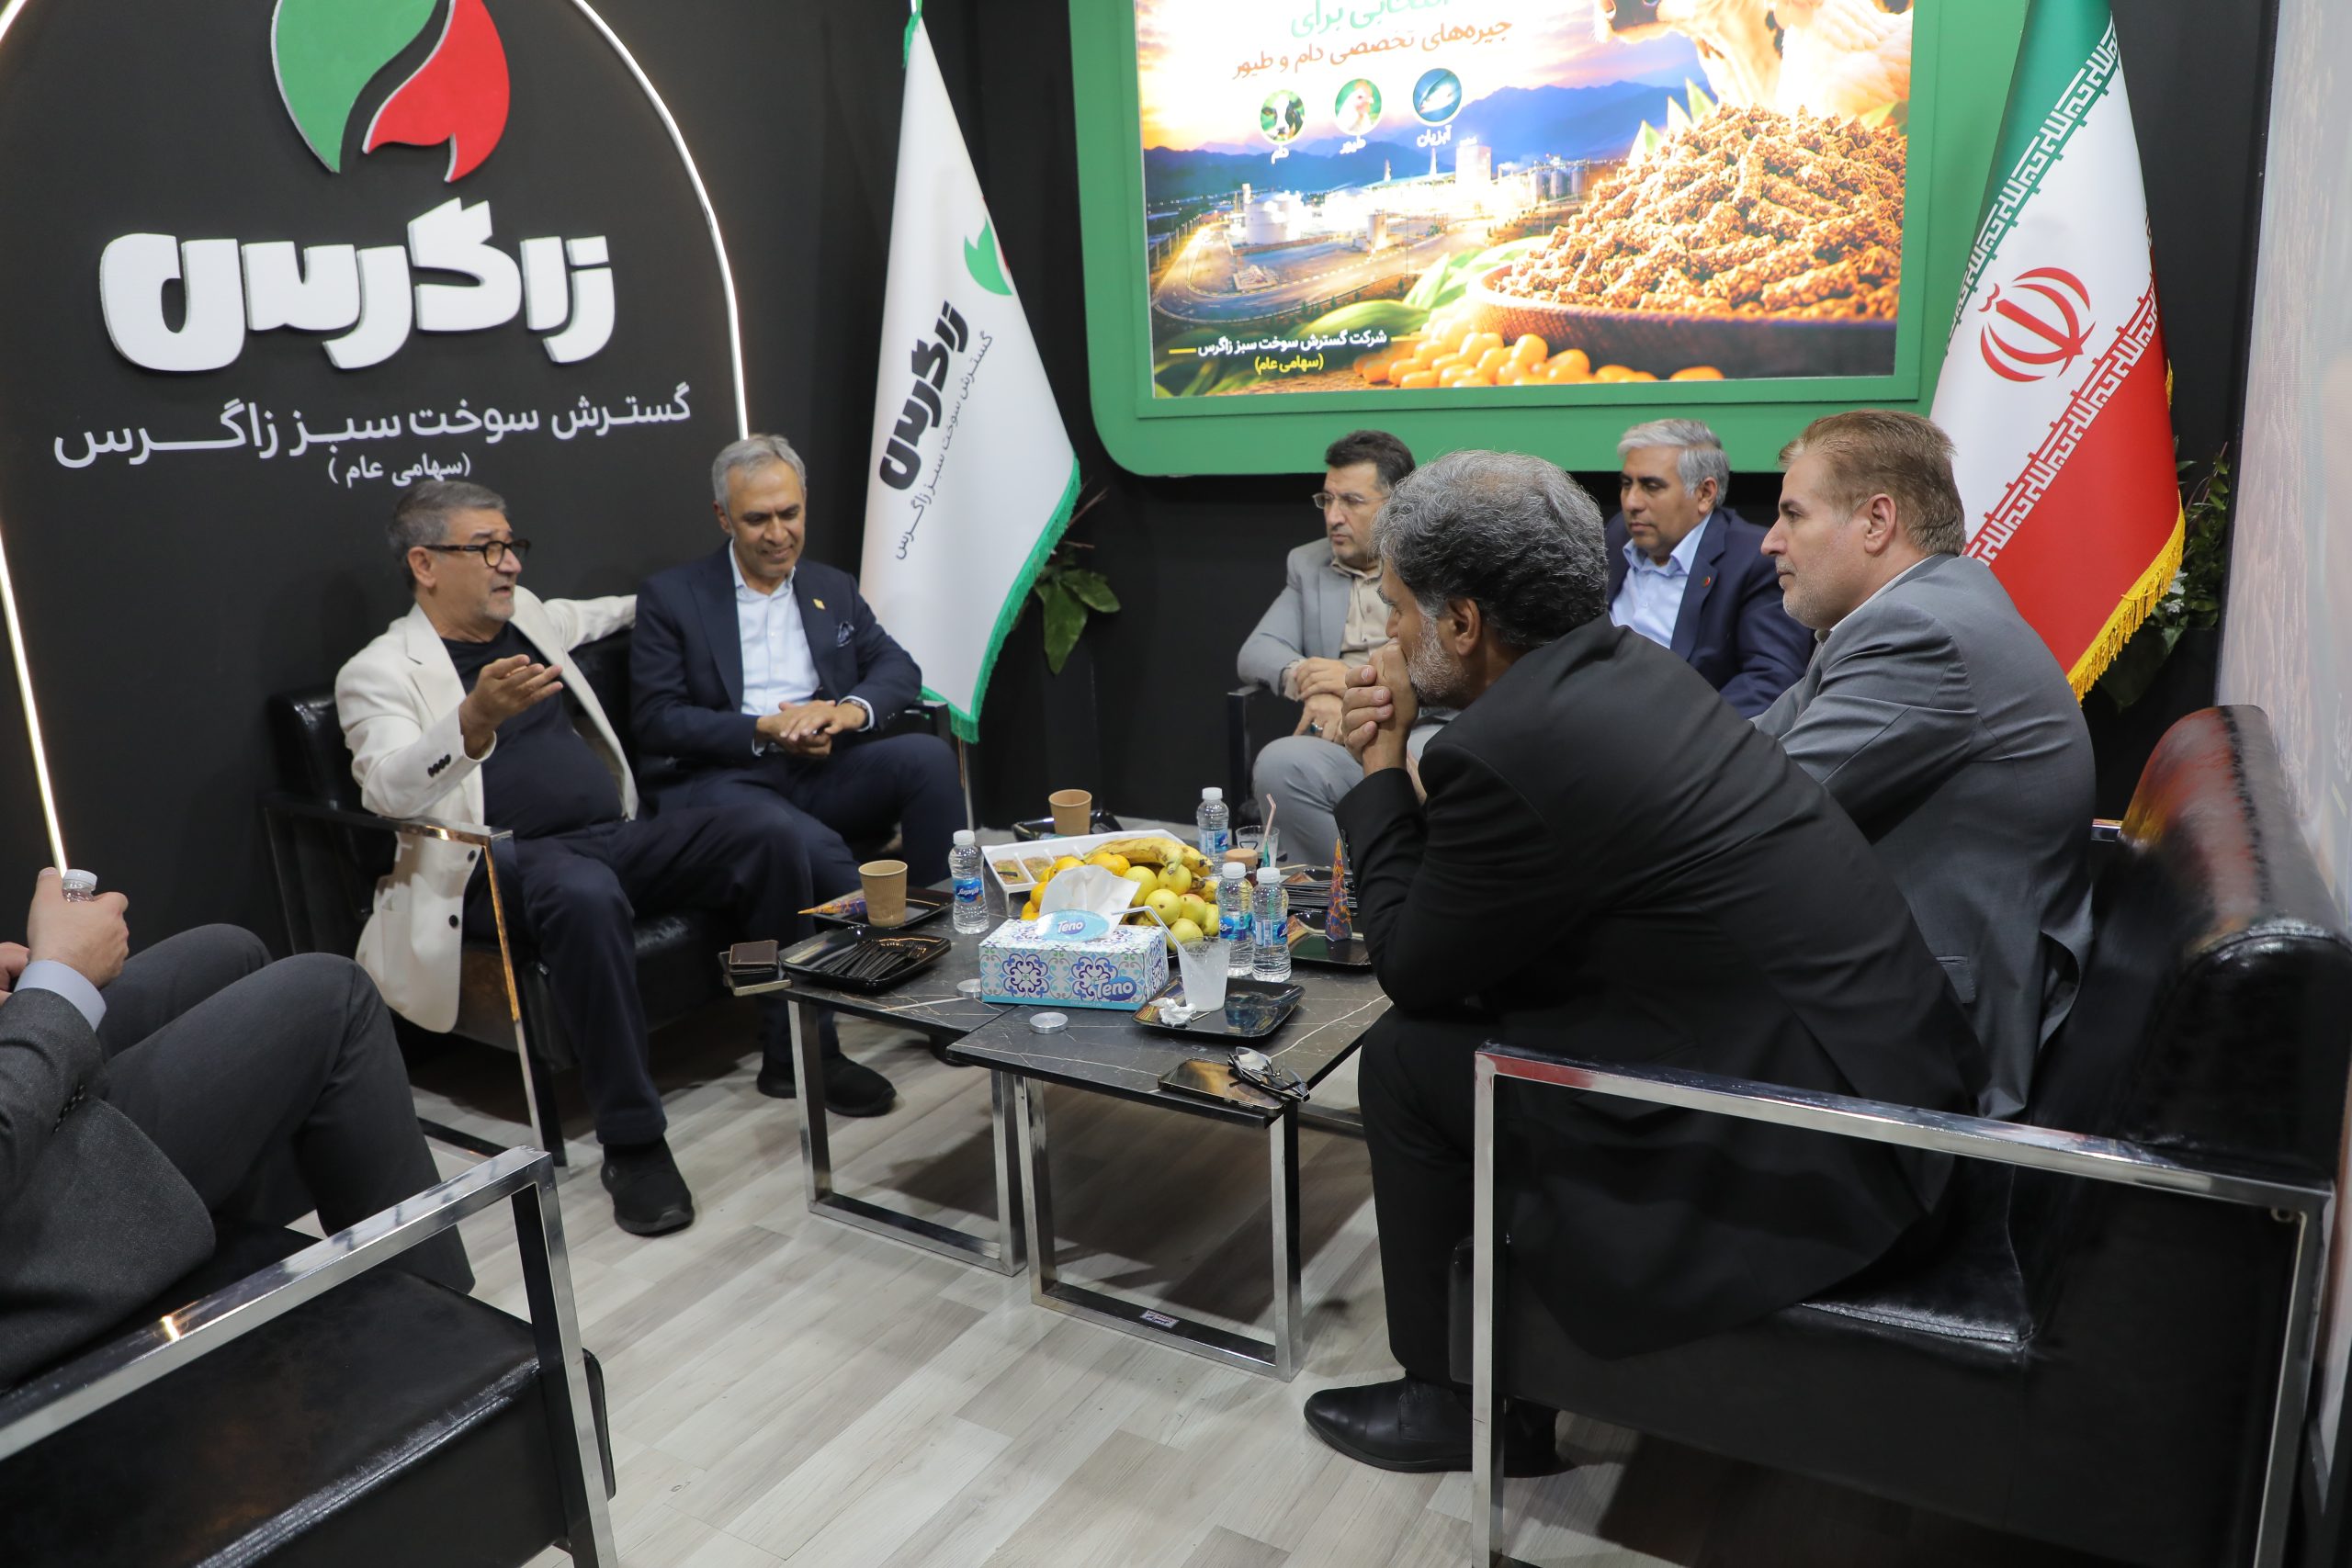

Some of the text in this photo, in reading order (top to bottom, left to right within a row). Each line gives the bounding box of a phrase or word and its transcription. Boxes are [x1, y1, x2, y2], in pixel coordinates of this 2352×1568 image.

[1295, 43, 1323, 73] دام
[1329, 30, 1415, 65] تخصصی
[1232, 51, 1273, 80] طیور
[1279, 55, 1289, 73] و
[99, 197, 616, 372] زاگرس
[1197, 328, 1387, 357] شرکت گسترش سوخت سبز زاگرس
[879, 300, 969, 491] زاگرس
[54, 382, 691, 468] گسترش سوخت سبز زاگرس
[896, 330, 993, 560] گسترش سوخت سبز زاگرس
[1057, 920, 1084, 934] Teno
[1094, 979, 1135, 999] Teno
